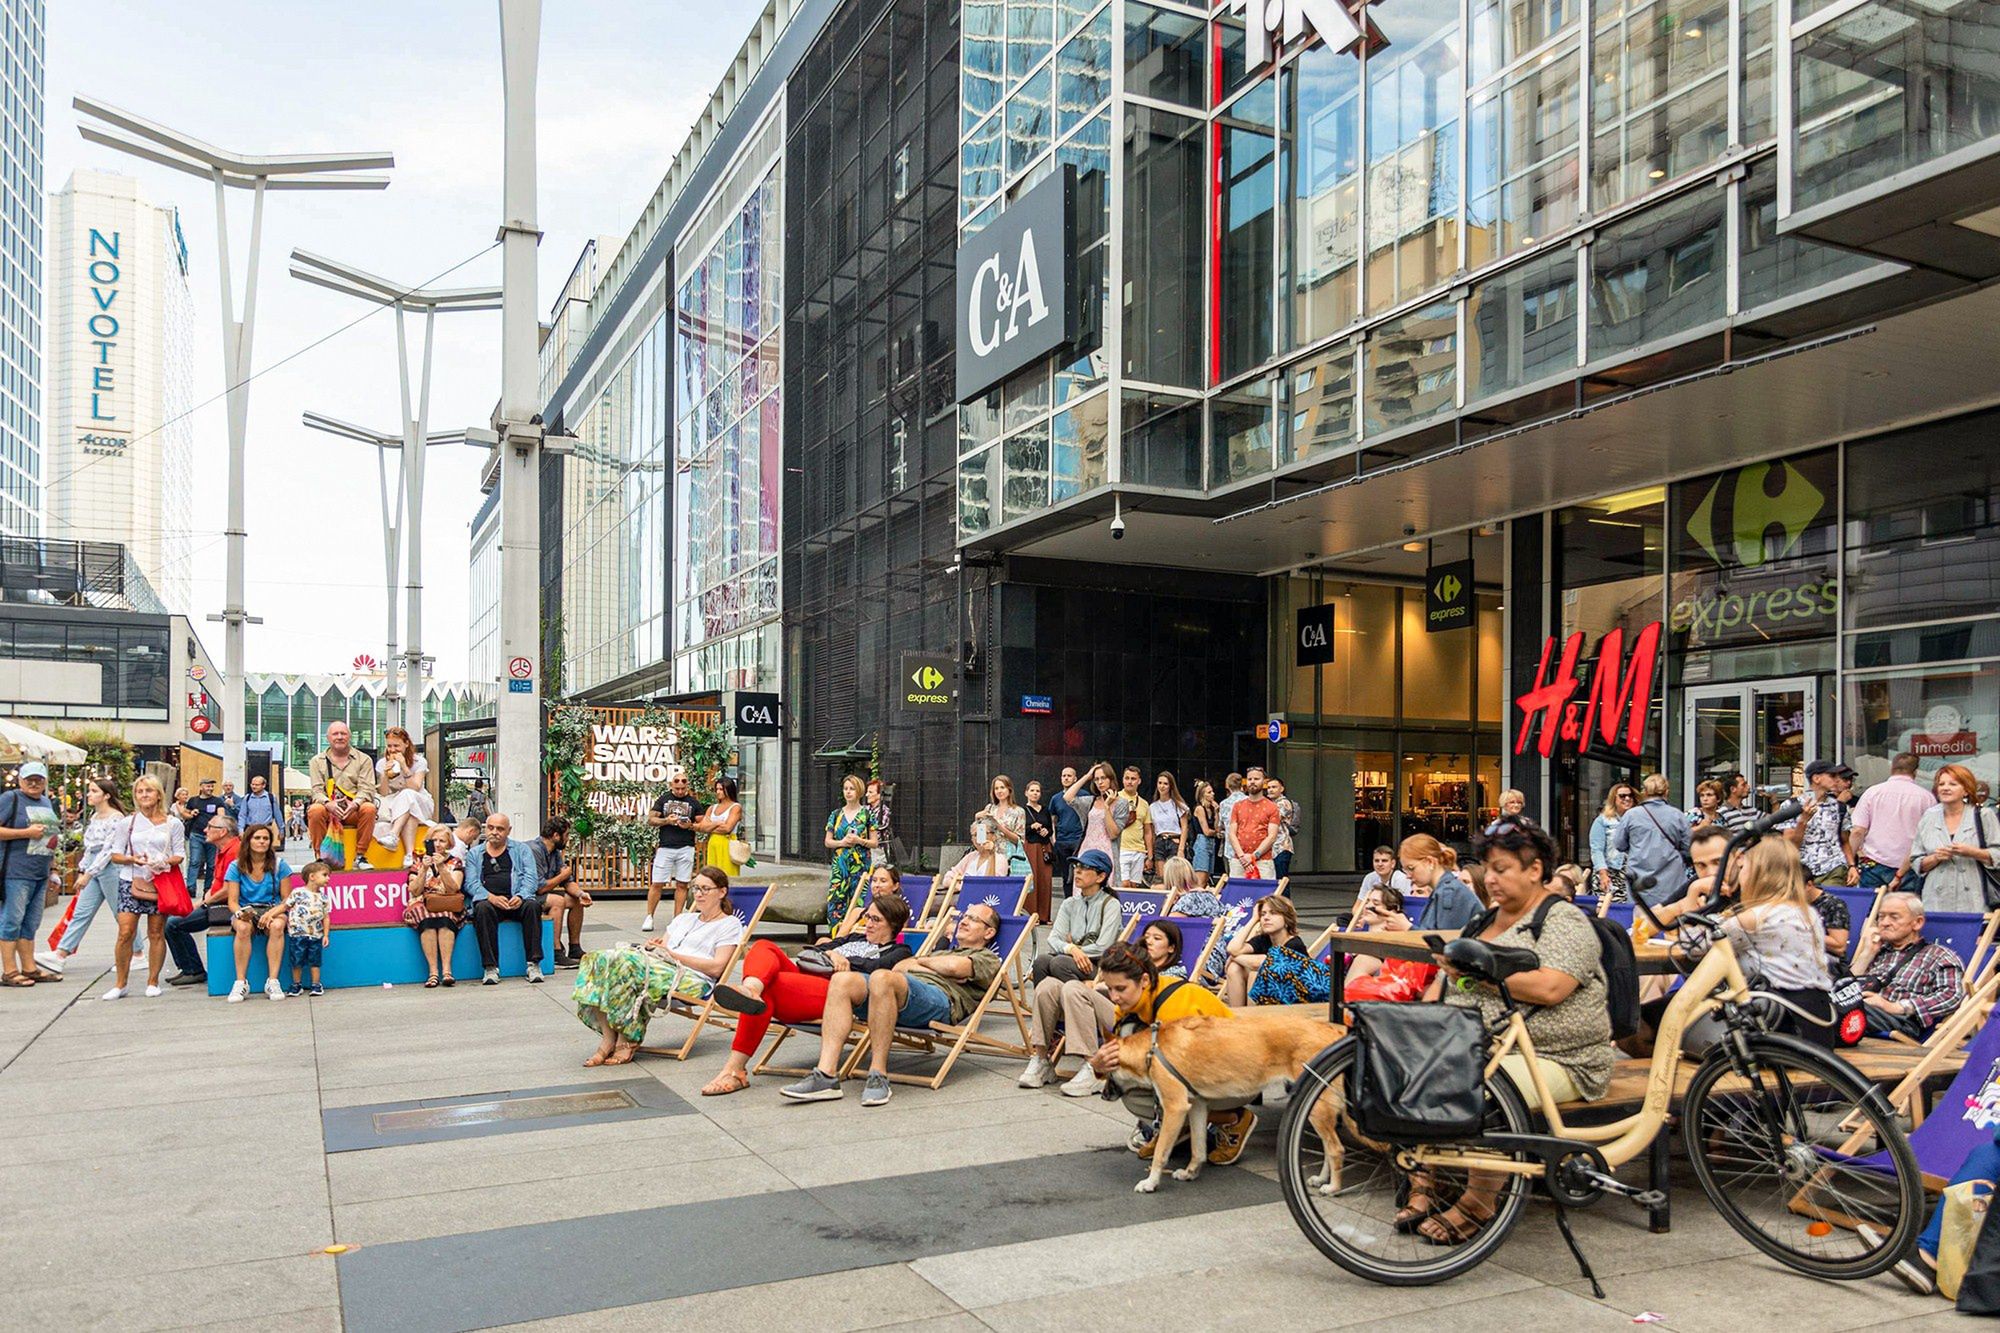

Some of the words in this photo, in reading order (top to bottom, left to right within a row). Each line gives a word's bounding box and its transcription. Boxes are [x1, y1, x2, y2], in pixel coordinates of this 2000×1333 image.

[969, 228, 1049, 357] C&A
[89, 228, 120, 421] NOVOTEL
[78, 433, 127, 448] ACCOR
[1430, 606, 1466, 622] express
[1670, 579, 1838, 639] express
[1301, 623, 1327, 648] C&A
[907, 693, 949, 705] express
[1515, 621, 1661, 758] H&M
[741, 705, 773, 724] C&A
[593, 744, 674, 763] SAWA
[1915, 741, 1973, 754] inmedio
[1120, 901, 1157, 915] SMOS
